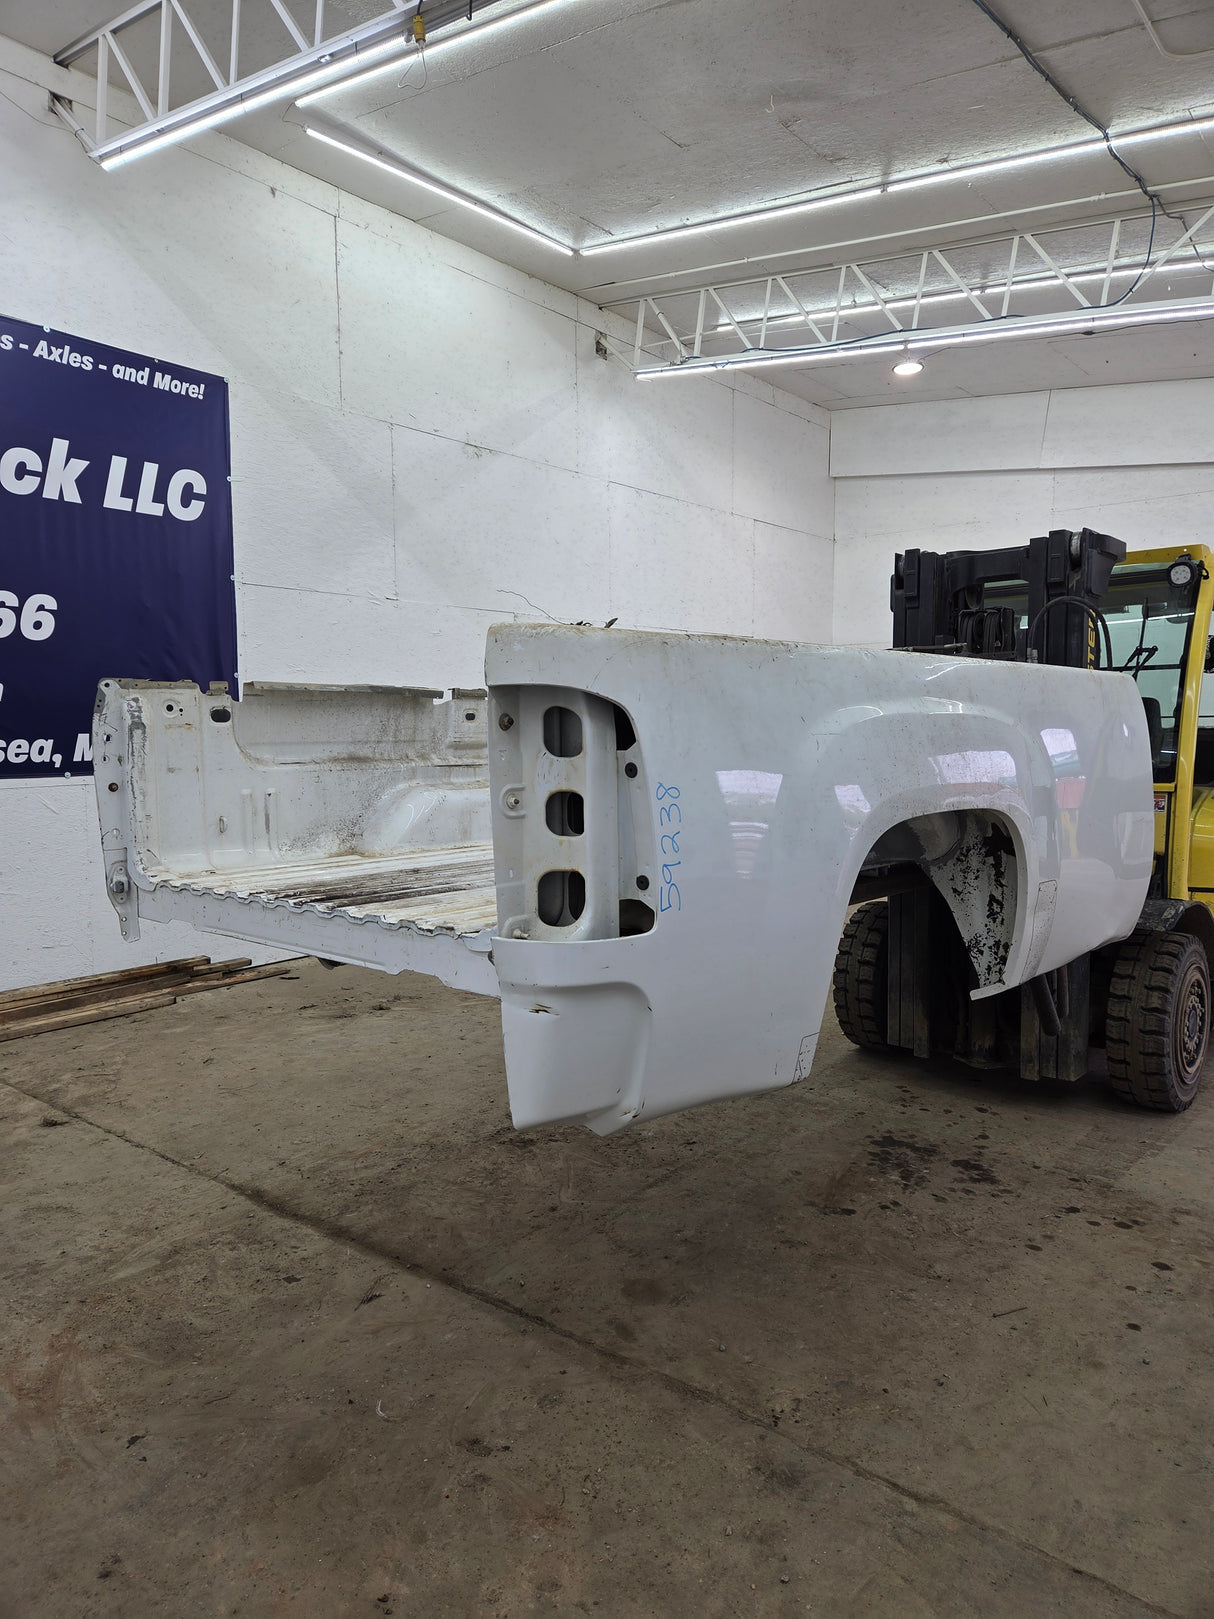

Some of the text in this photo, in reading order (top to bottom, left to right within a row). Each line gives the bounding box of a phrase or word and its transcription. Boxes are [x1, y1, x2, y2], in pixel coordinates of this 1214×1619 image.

[0, 334, 14, 350] s
[33, 340, 94, 371] Axles
[112, 363, 150, 385] and
[153, 371, 205, 399] More!
[0, 437, 207, 521] ck LLC
[656, 782, 681, 912] 59238
